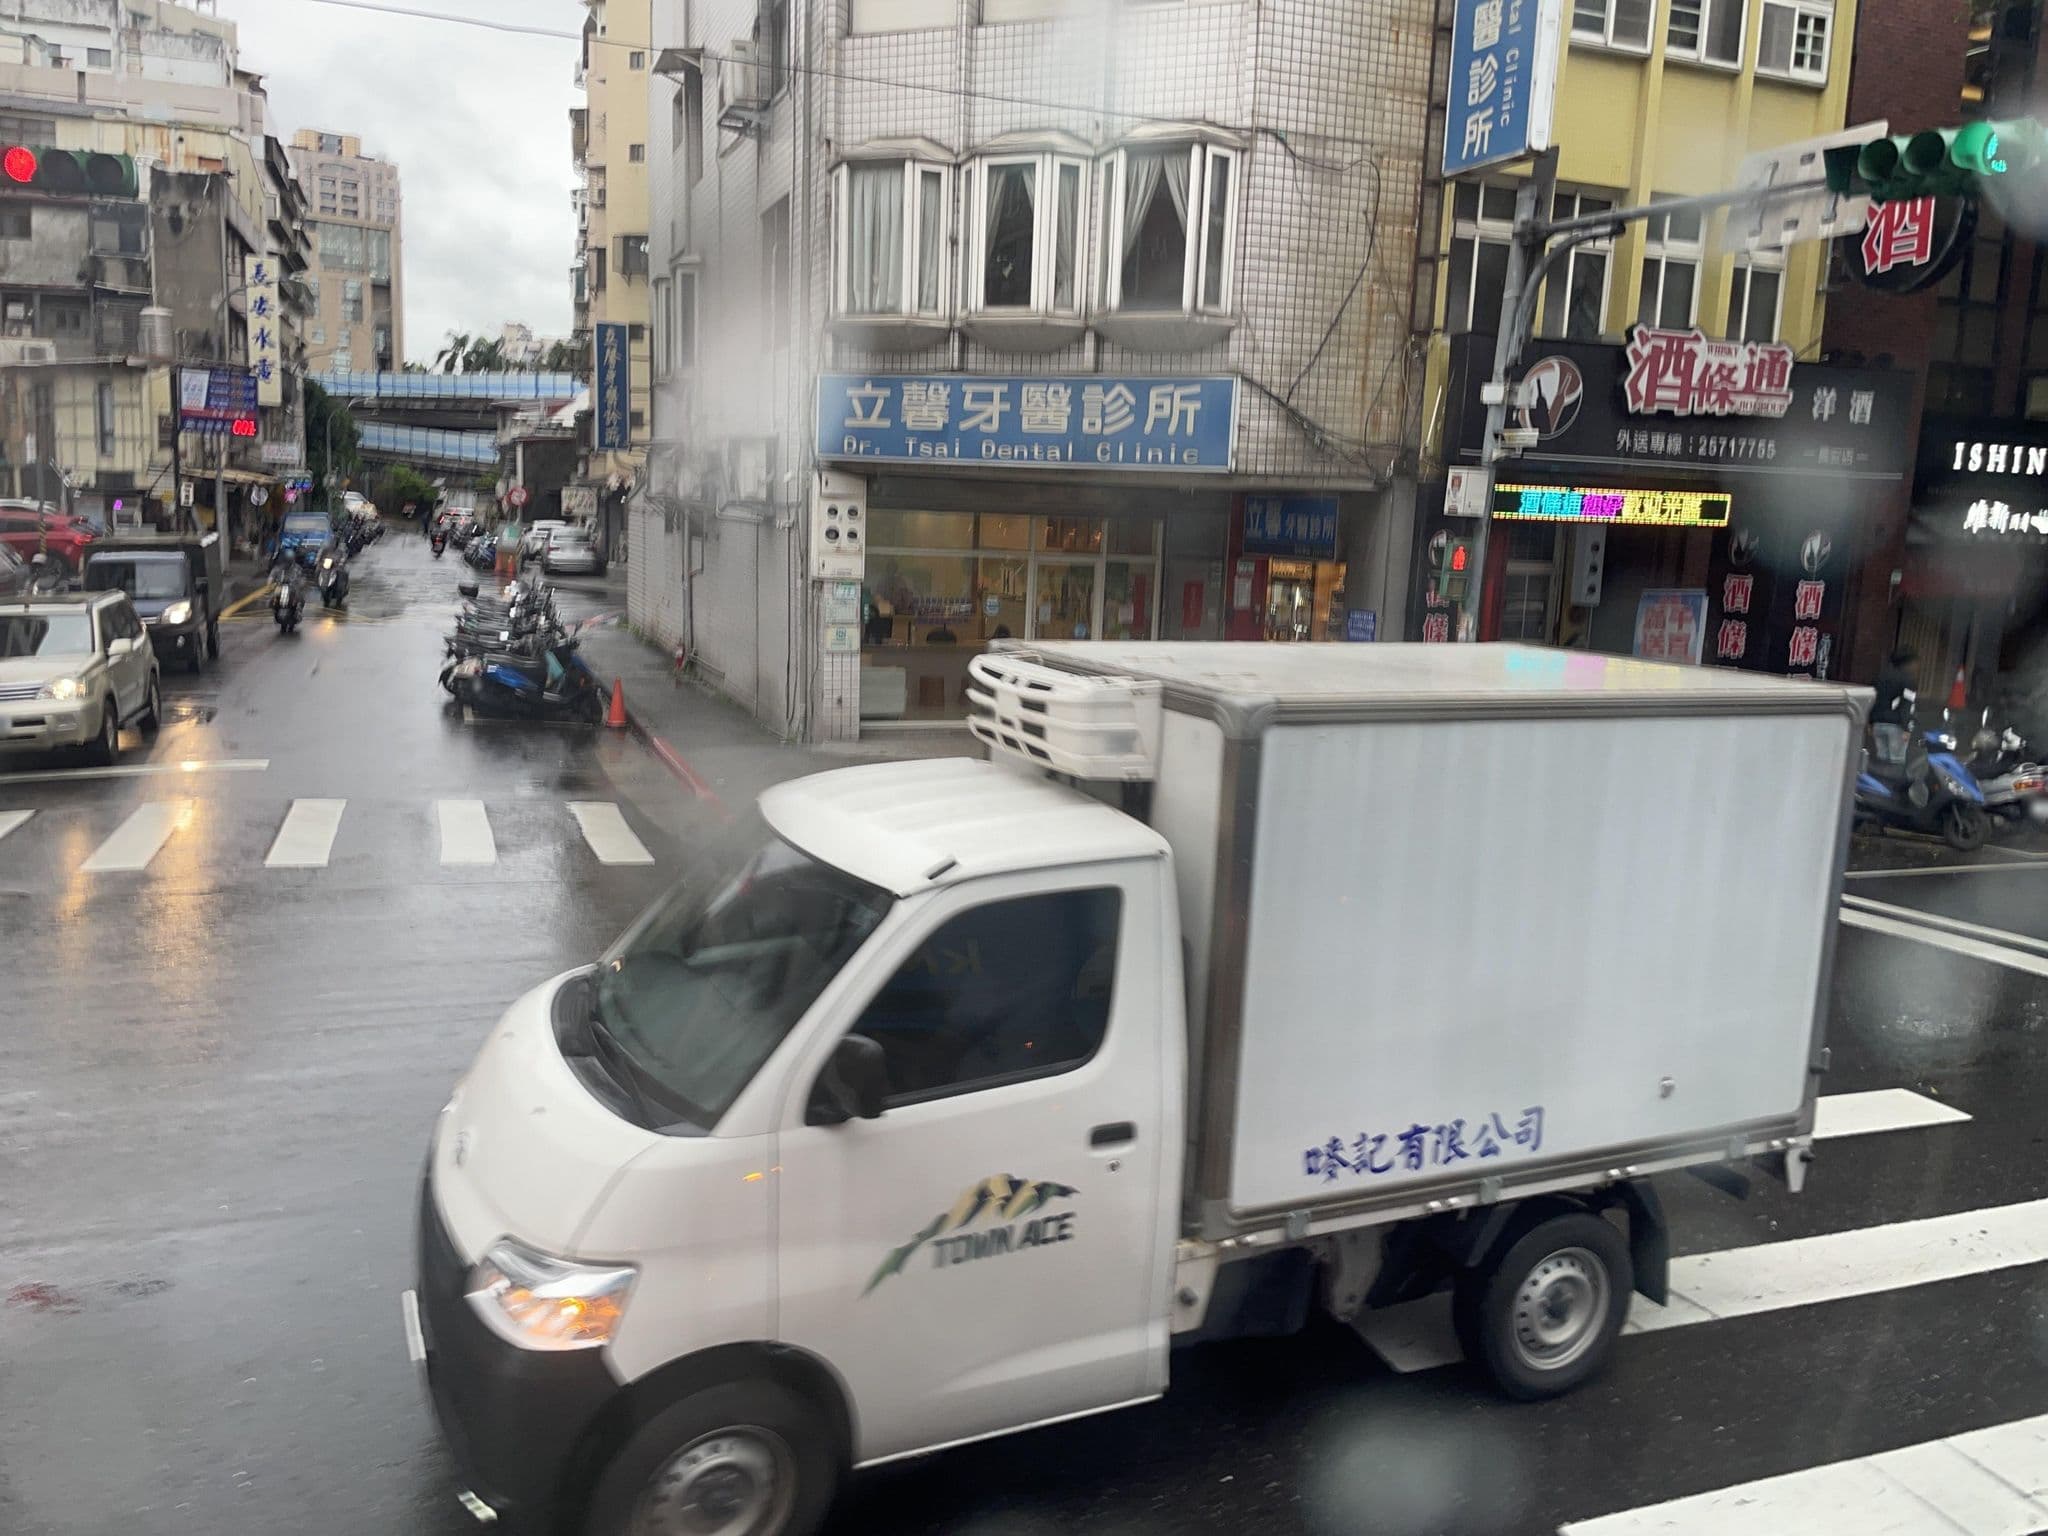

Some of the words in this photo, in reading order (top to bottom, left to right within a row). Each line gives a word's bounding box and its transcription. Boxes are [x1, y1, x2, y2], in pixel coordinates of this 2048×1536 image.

[1500, 47, 1519, 128] Clinic
[843, 435, 881, 456] Dr.
[905, 436, 961, 458] Tsai
[981, 439, 1073, 463] Dental
[1097, 441, 1199, 464] Clinic
[1953, 441, 2048, 476] ISHIN
[1717, 573, 1754, 660] 酒條
[1788, 579, 1825, 680] 酒條
[931, 1224, 1016, 1269] TOWN
[1017, 1211, 1077, 1250] ACE
